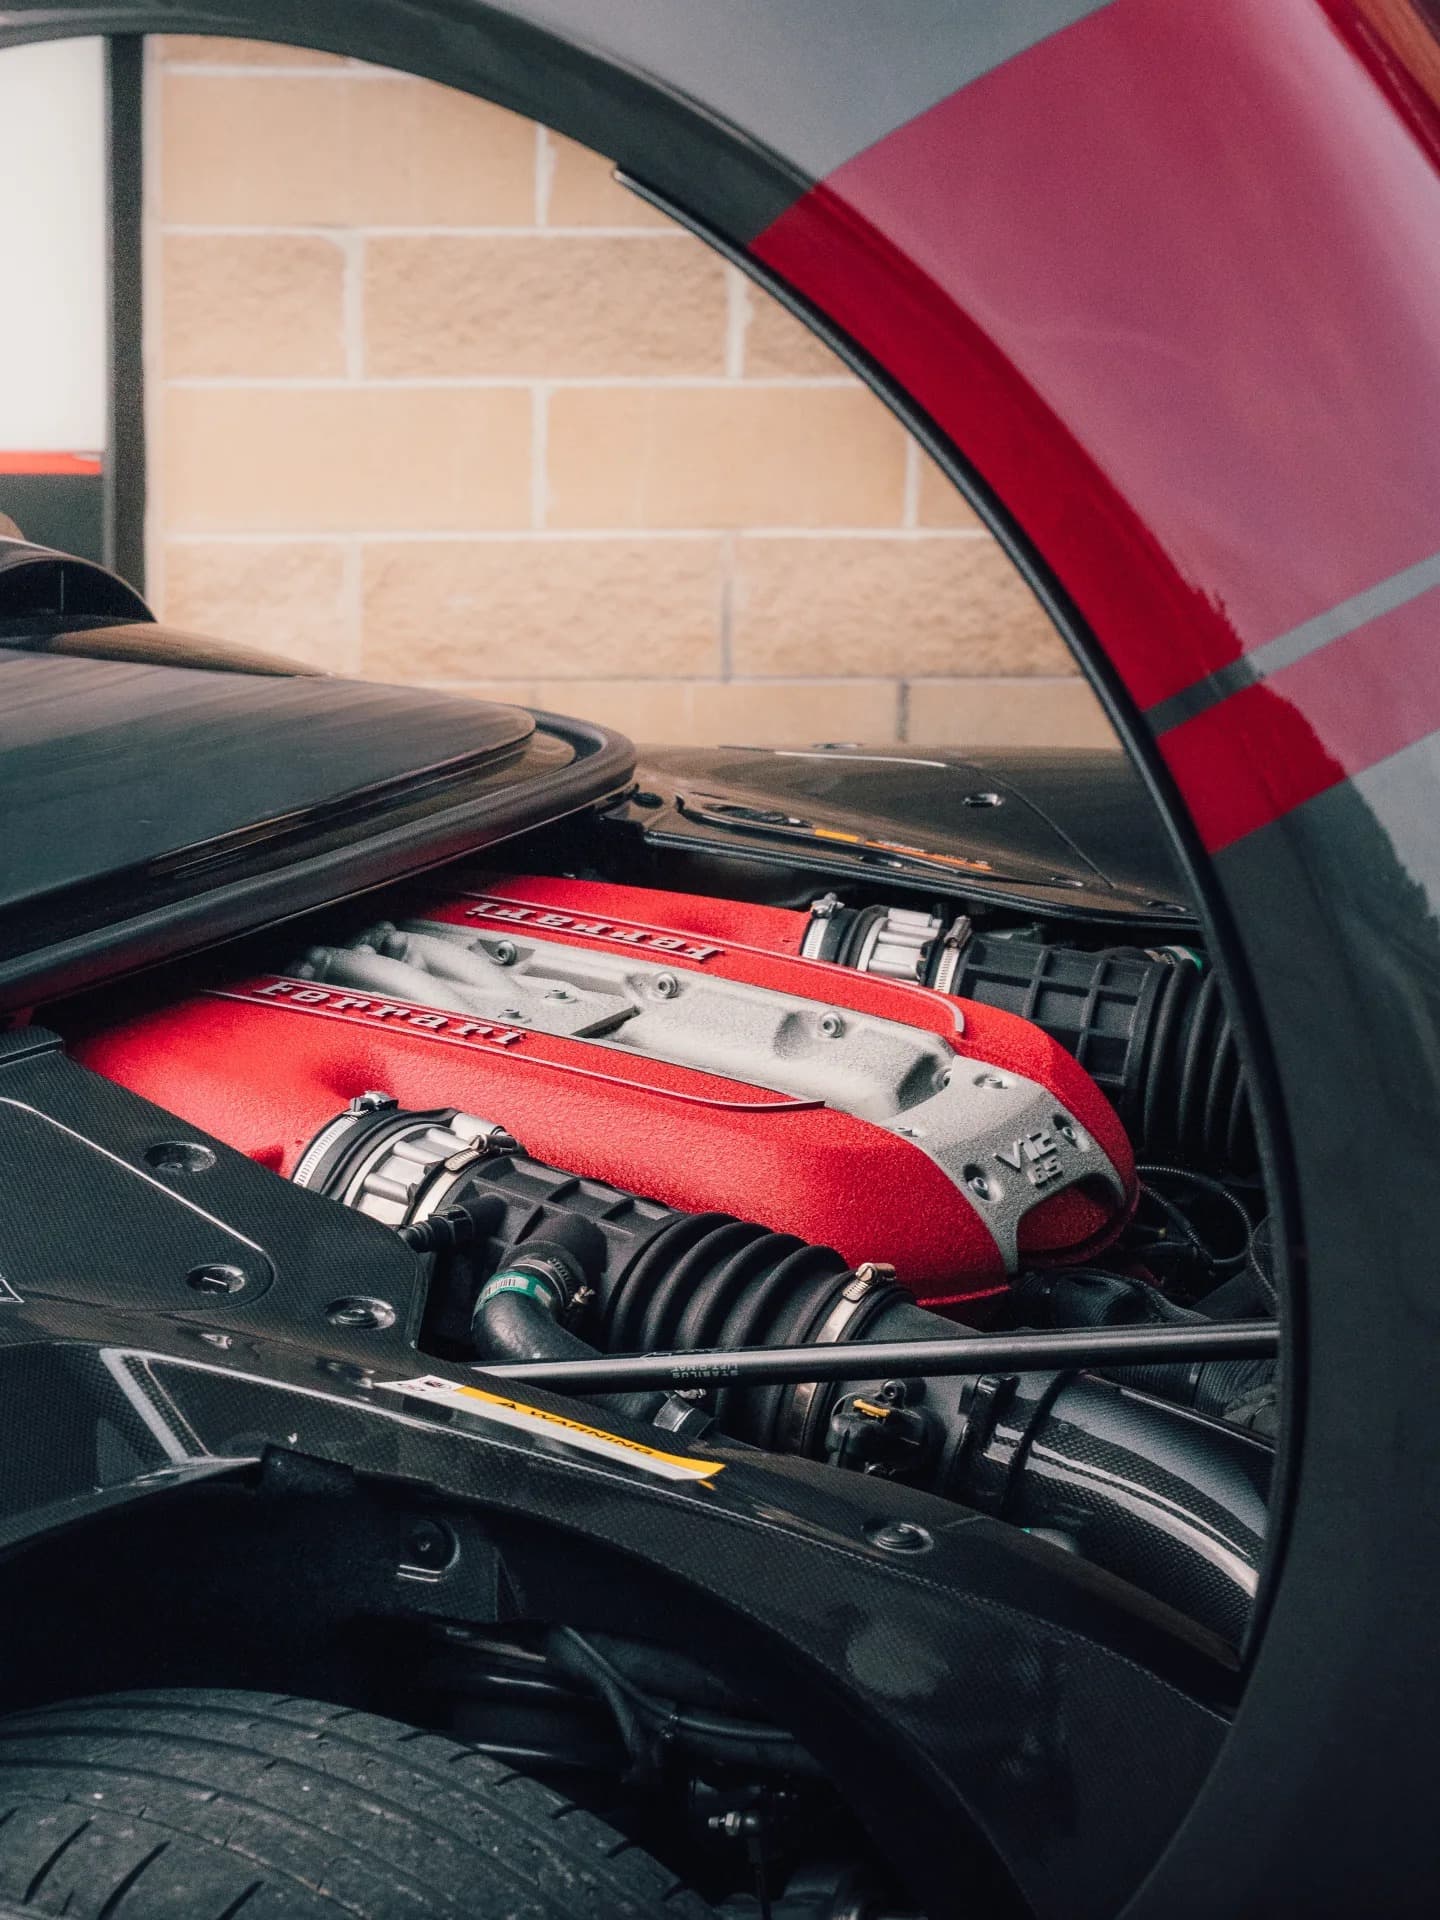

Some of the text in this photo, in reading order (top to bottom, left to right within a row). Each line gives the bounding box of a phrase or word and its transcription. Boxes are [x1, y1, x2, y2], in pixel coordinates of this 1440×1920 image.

[466, 902, 724, 960] Ferrari
[255, 981, 527, 1046] Ferrari
[1027, 1156, 1063, 1184] 65
[530, 1411, 654, 1455] WARNING
